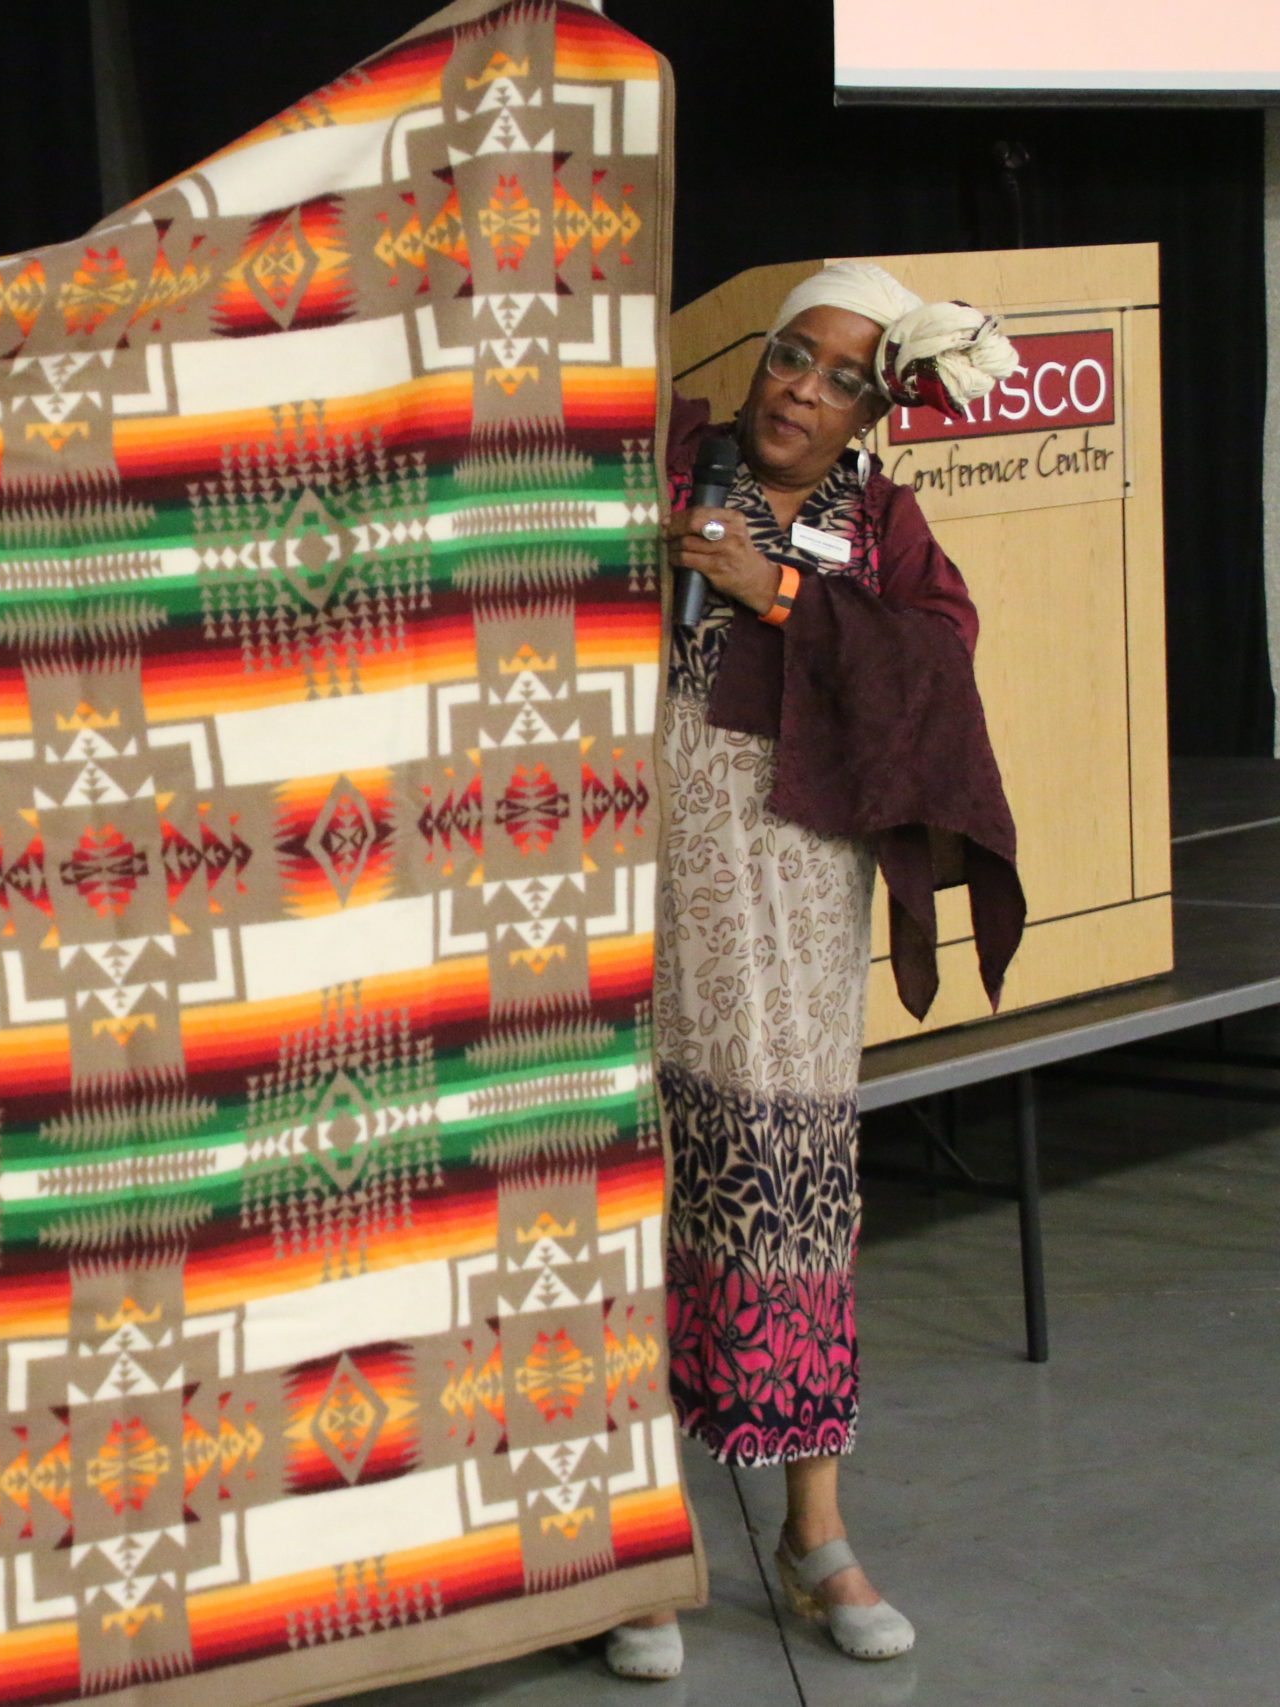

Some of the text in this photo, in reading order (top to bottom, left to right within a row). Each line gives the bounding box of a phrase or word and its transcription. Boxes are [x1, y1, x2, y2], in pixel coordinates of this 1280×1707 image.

[900, 359, 1107, 430] ISCO
[892, 430, 1114, 496] Conference Center
